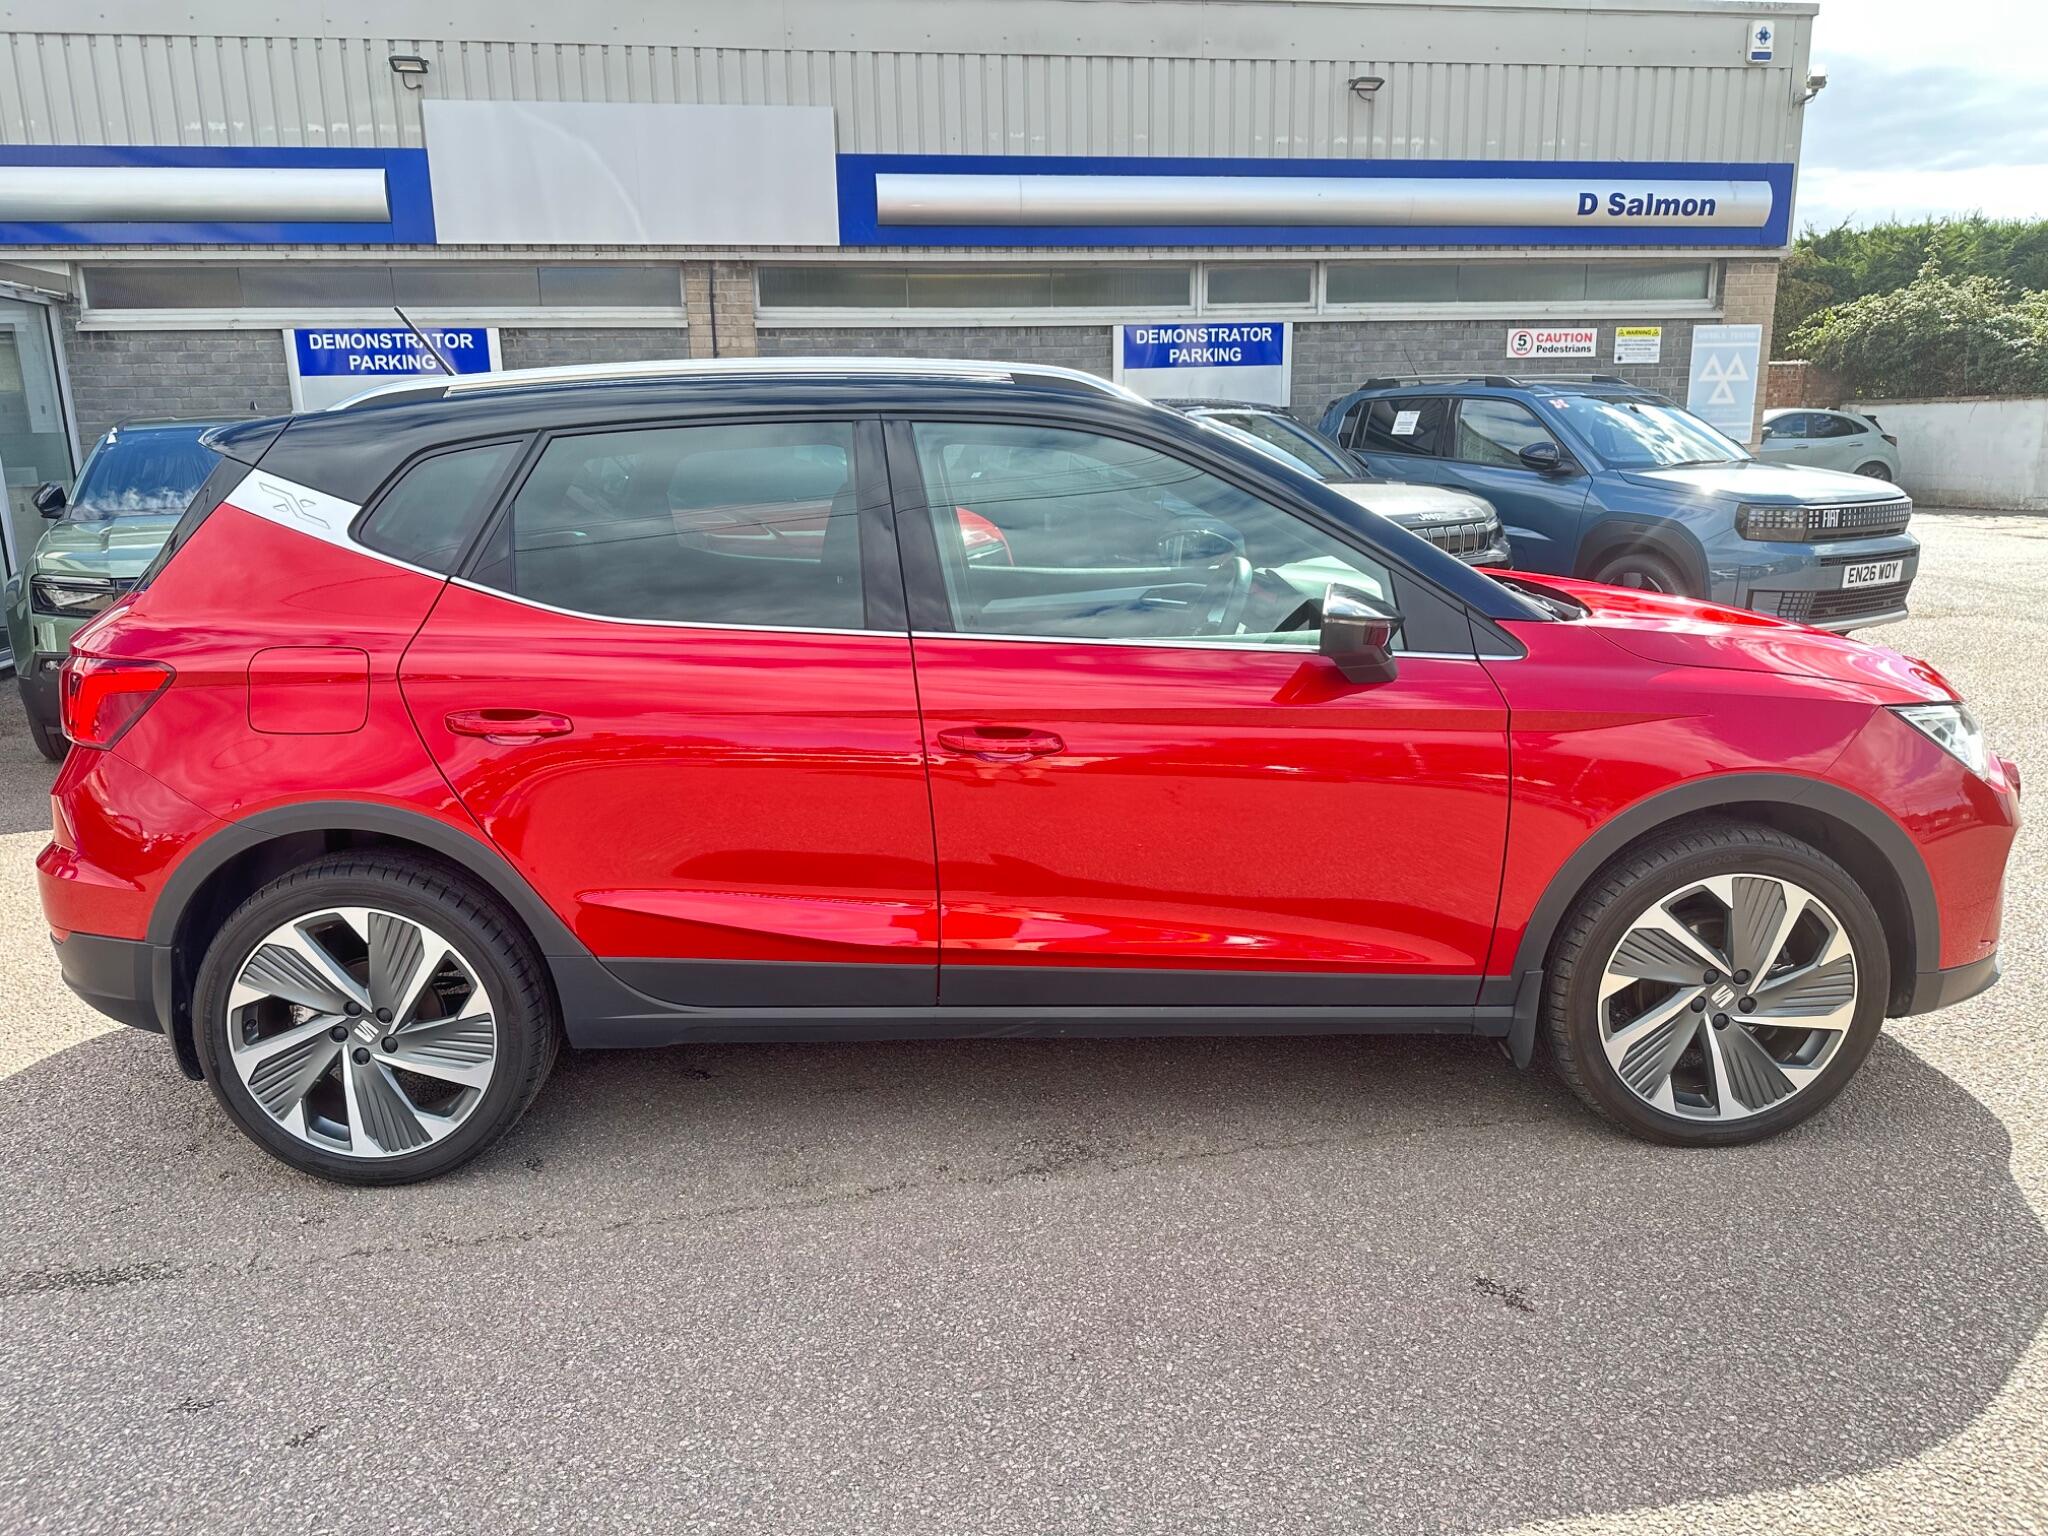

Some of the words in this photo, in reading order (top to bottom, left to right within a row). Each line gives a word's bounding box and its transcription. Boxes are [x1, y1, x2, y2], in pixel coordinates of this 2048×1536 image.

[1577, 192, 1598, 216] D
[1607, 192, 1716, 217] Salmon
[308, 333, 474, 350] DEMONSTRATOR
[1136, 327, 1272, 345] DEMONSTRATOR
[1517, 334, 1527, 347] 5
[1536, 333, 1592, 343] CAUTION
[1169, 347, 1242, 363] PARKING
[1536, 344, 1592, 353] Pedestrians
[349, 354, 437, 371] PARKING
[1417, 512, 1441, 521] Jeep
[1822, 509, 1840, 528] FIAT
[1847, 565, 1877, 584] EN26
